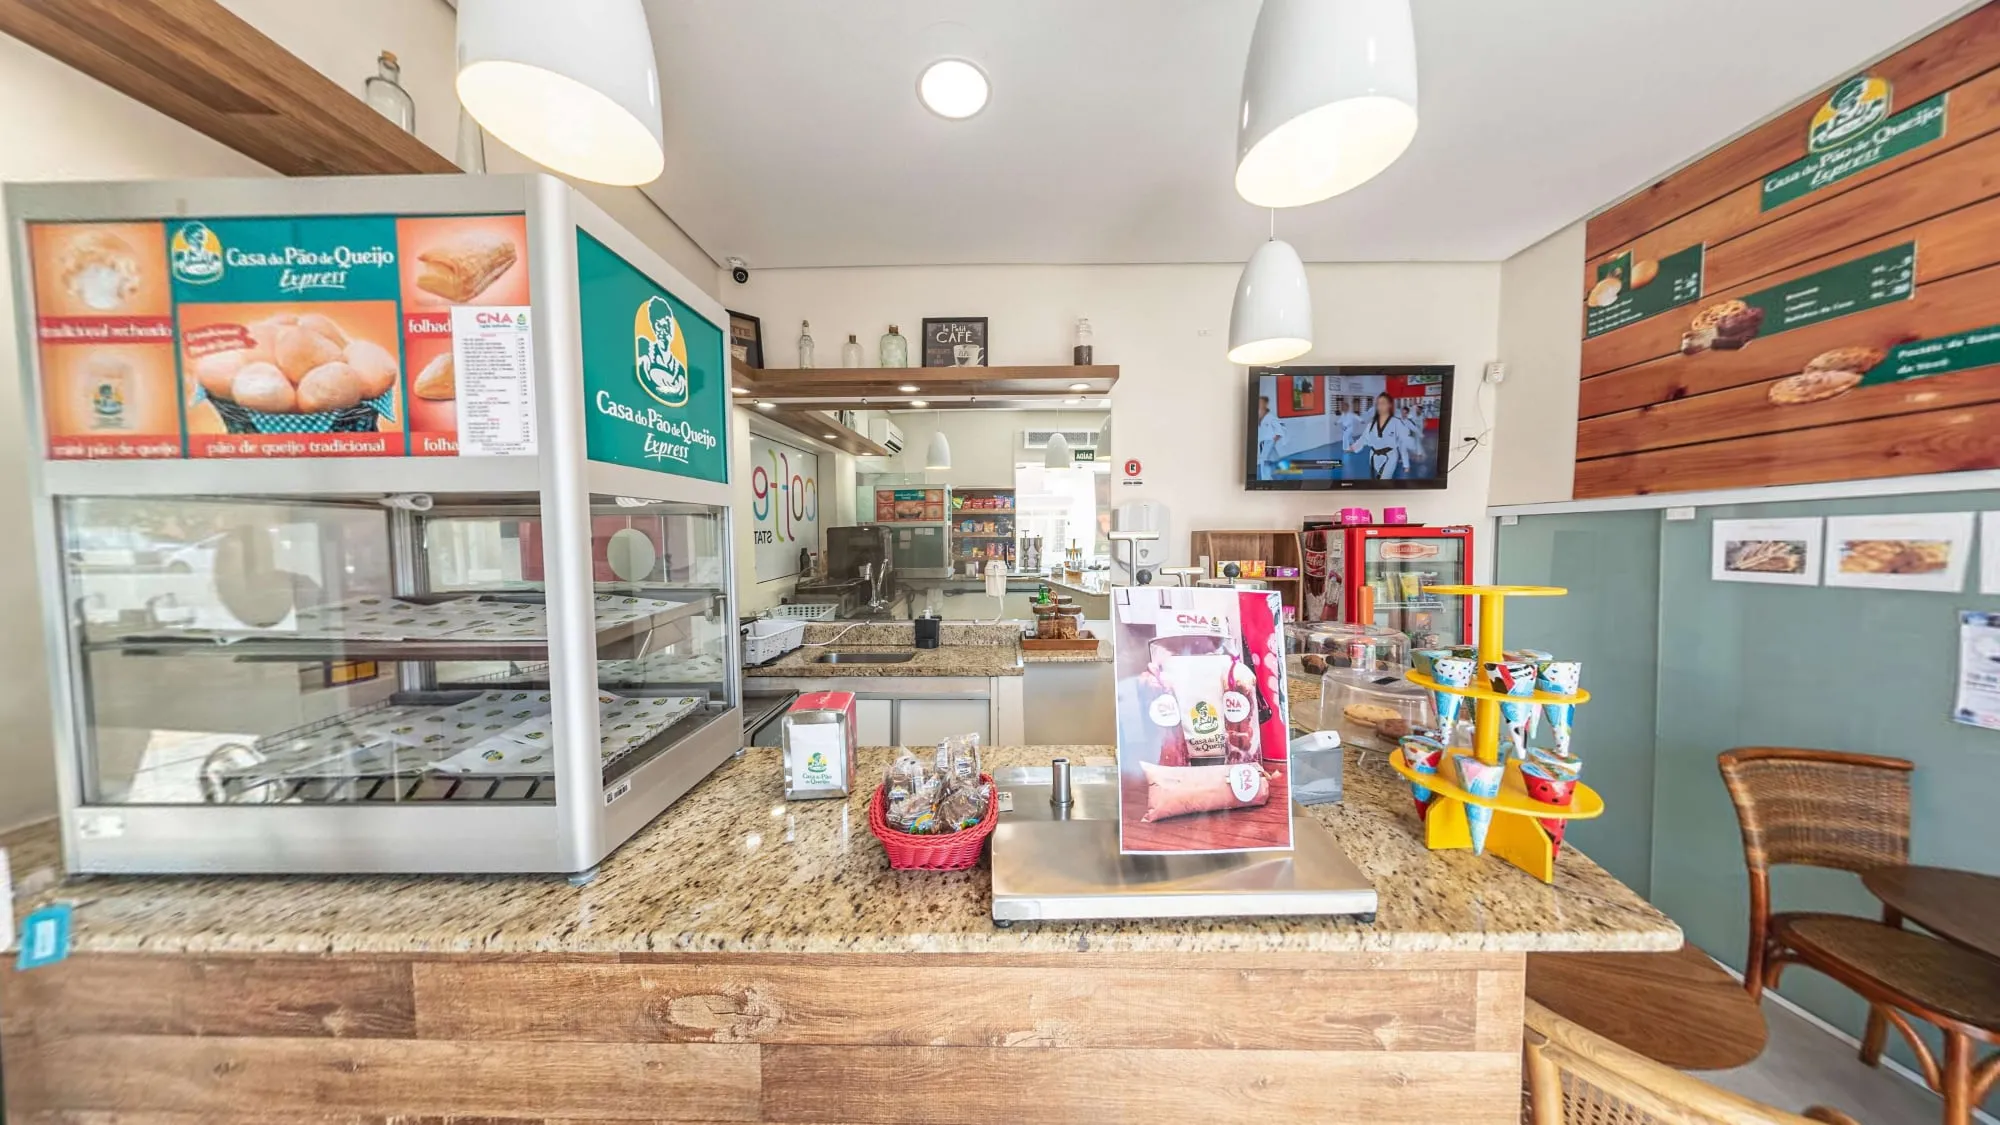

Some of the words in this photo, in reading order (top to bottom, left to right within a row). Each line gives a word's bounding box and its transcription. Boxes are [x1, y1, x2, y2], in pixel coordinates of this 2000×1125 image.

[1764, 171, 1800, 193] Casa
[1819, 146, 1851, 169] Pão
[1871, 105, 1944, 145] Queijo
[1810, 145, 1882, 188] Express
[226, 247, 268, 267] Casa
[267, 253, 285, 266] do
[284, 246, 318, 266] Pão
[319, 251, 335, 265] de
[334, 246, 395, 269] Queijo
[279, 268, 349, 293] Express
[475, 312, 513, 324] CNA
[595, 390, 634, 422] Casa
[634, 410, 648, 426] do
[647, 408, 671, 434] Pão
[671, 423, 681, 437] de
[680, 421, 716, 450] Queijo
[207, 441, 236, 457] pão
[238, 439, 257, 453] de
[261, 439, 305, 457] queijo
[309, 438, 386, 453] tradicional
[643, 432, 690, 463] Express
[1176, 614, 1209, 625] CNA
[1225, 698, 1242, 708] CNA
[1189, 738, 1208, 746] Casa
